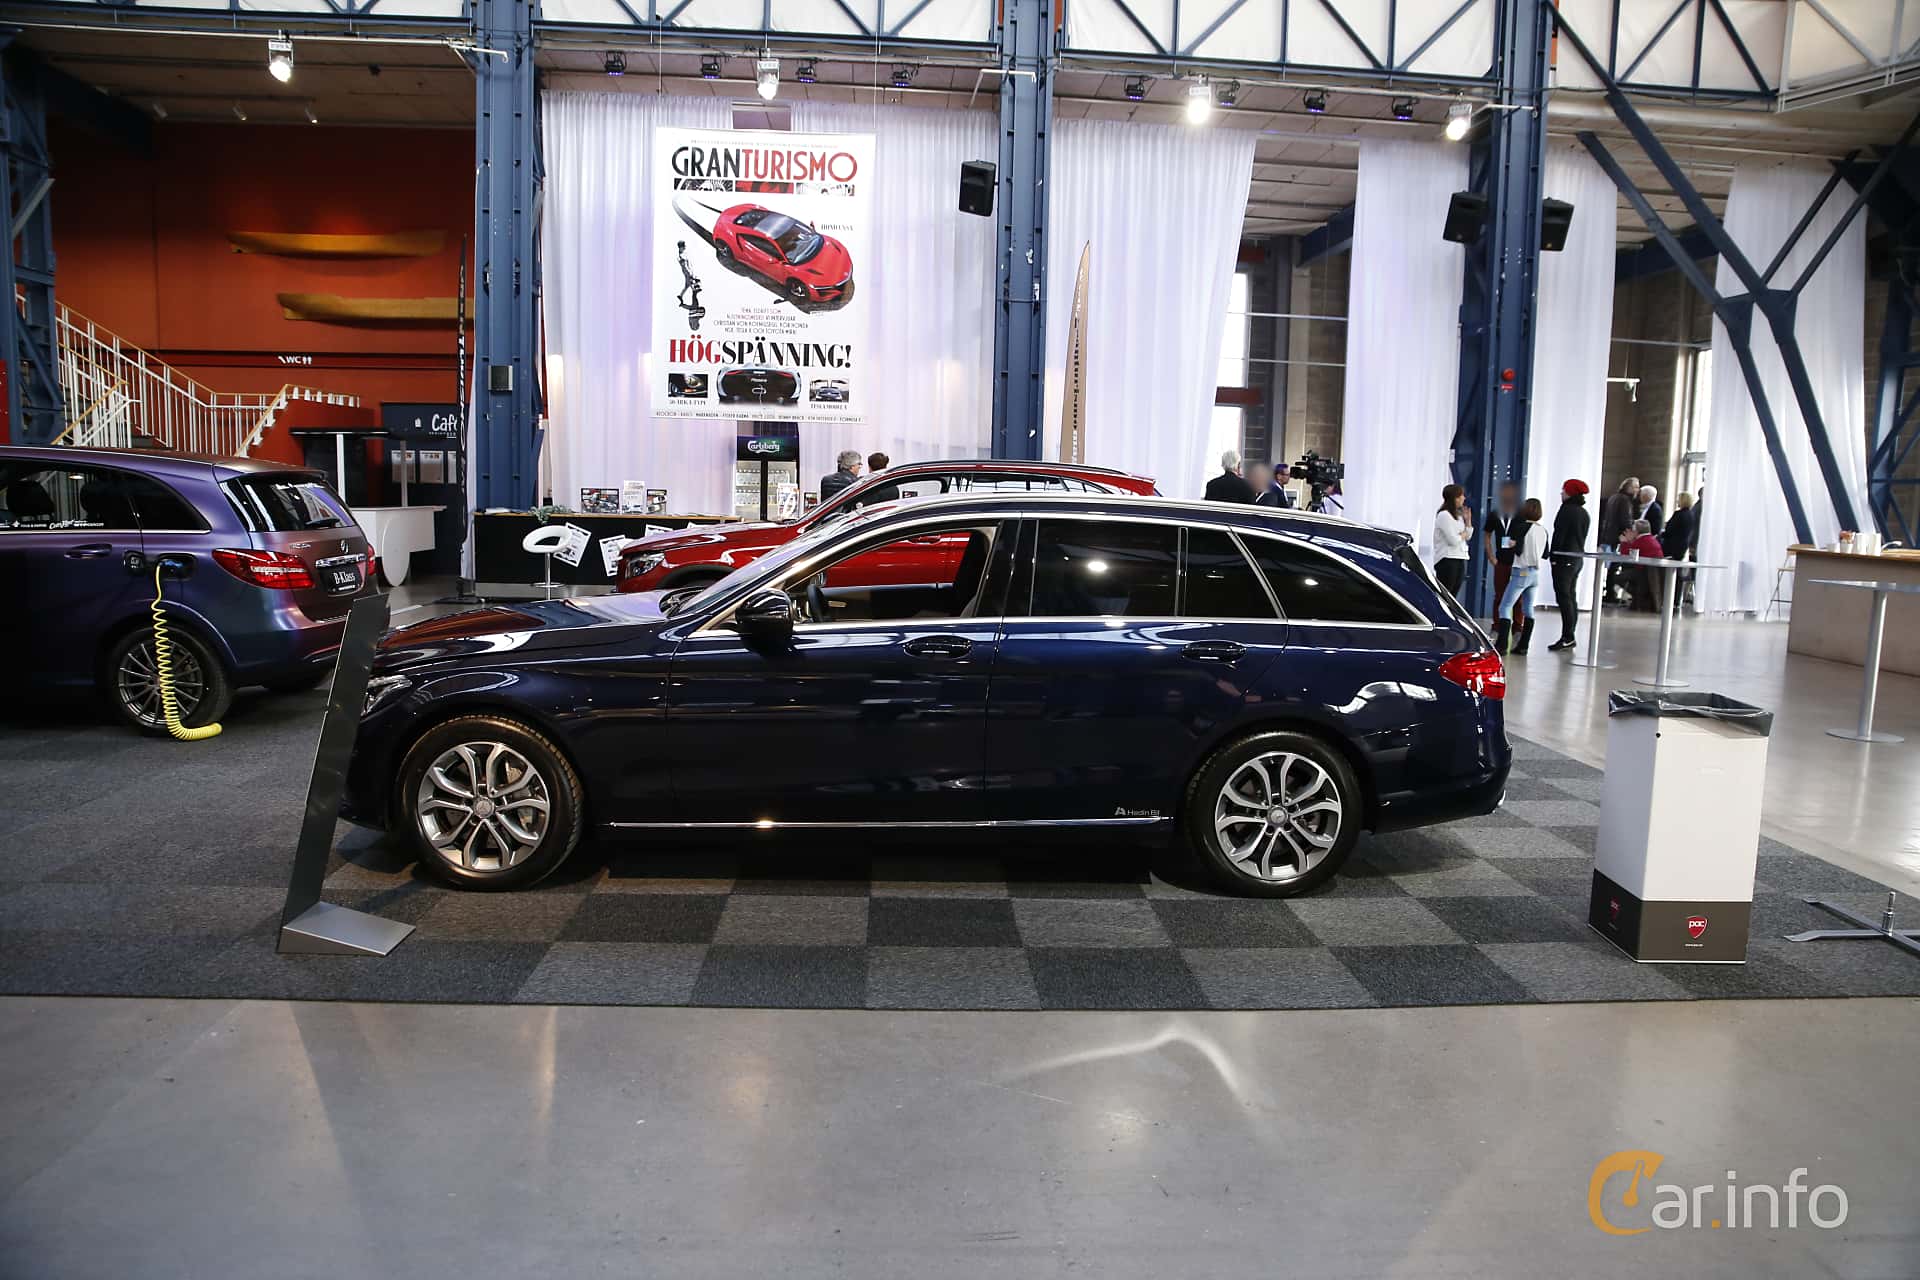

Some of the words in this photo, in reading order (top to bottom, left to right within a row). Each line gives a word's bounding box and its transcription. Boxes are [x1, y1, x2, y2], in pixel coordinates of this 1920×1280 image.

[671, 146, 858, 182] GRANTURISMO
[286, 355, 302, 364] WC
[669, 334, 852, 369] HÖGSPÄNNING!
[747, 440, 780, 454] Carlsberg
